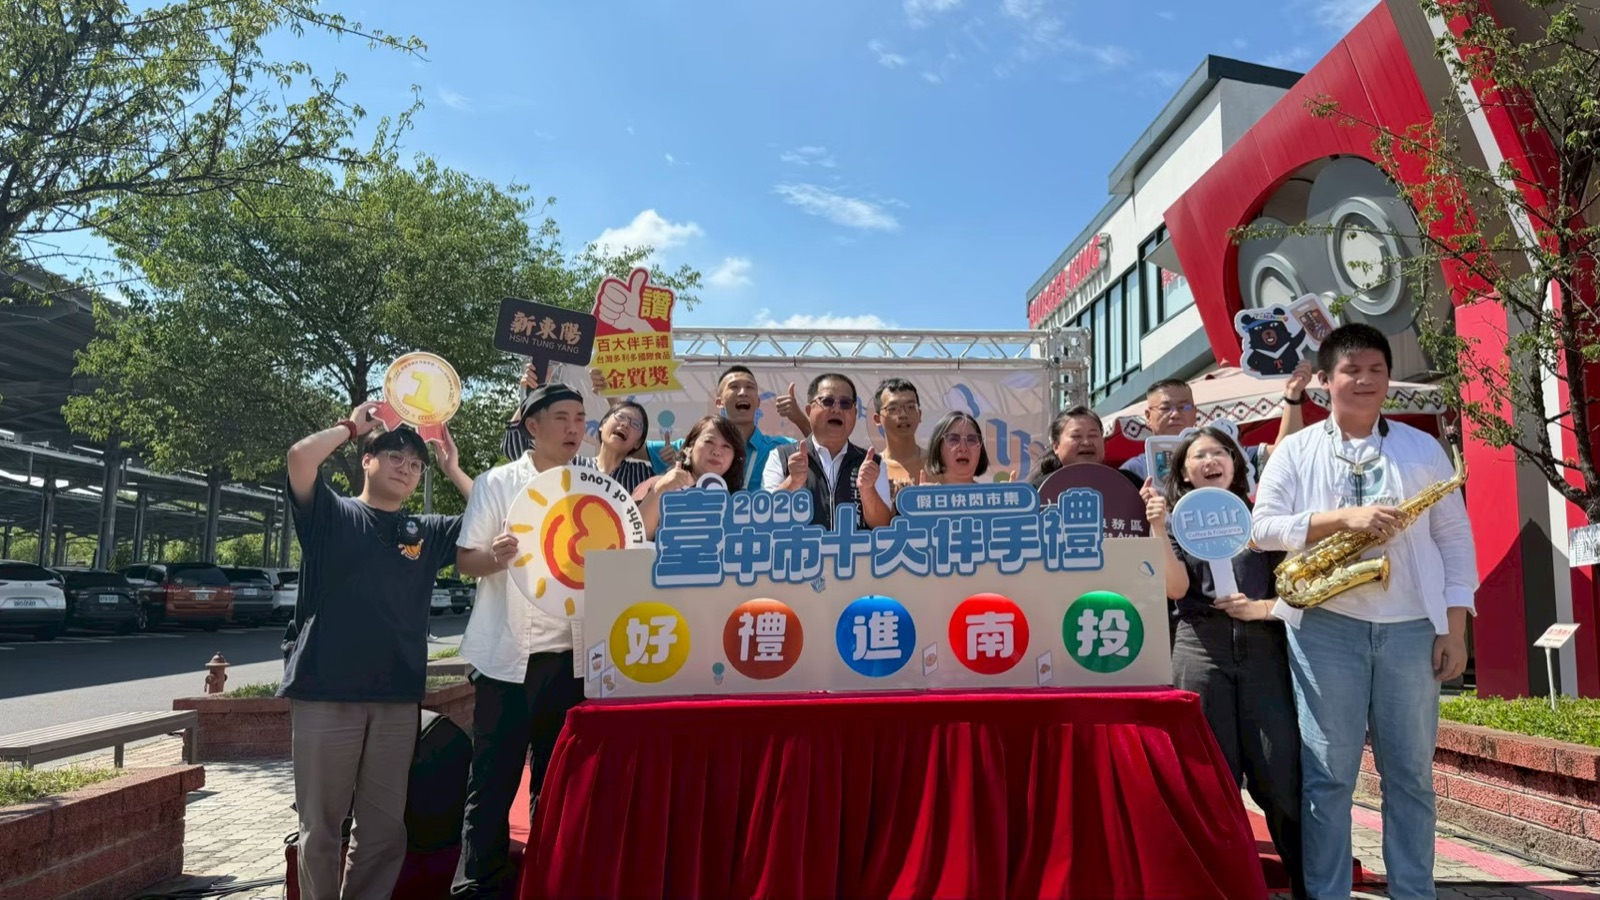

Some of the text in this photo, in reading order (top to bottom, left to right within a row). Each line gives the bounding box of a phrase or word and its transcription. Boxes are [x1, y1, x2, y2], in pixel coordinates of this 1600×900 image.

[1029, 234, 1102, 330] BURGER KING
[642, 287, 672, 321] 讚
[509, 333, 579, 354] HSIN TUNG YANG
[510, 311, 582, 345] 新東陽
[597, 335, 669, 353] 百大伴手禮
[606, 365, 669, 390] 金質獎
[580, 472, 643, 543] Light of Love
[732, 492, 811, 525] 2026
[916, 491, 1020, 509] 假日快閃市集
[1180, 506, 1240, 530] Flair
[655, 490, 1102, 587] 臺中市十大伴手禮
[625, 609, 1130, 666] 好禮進南投
